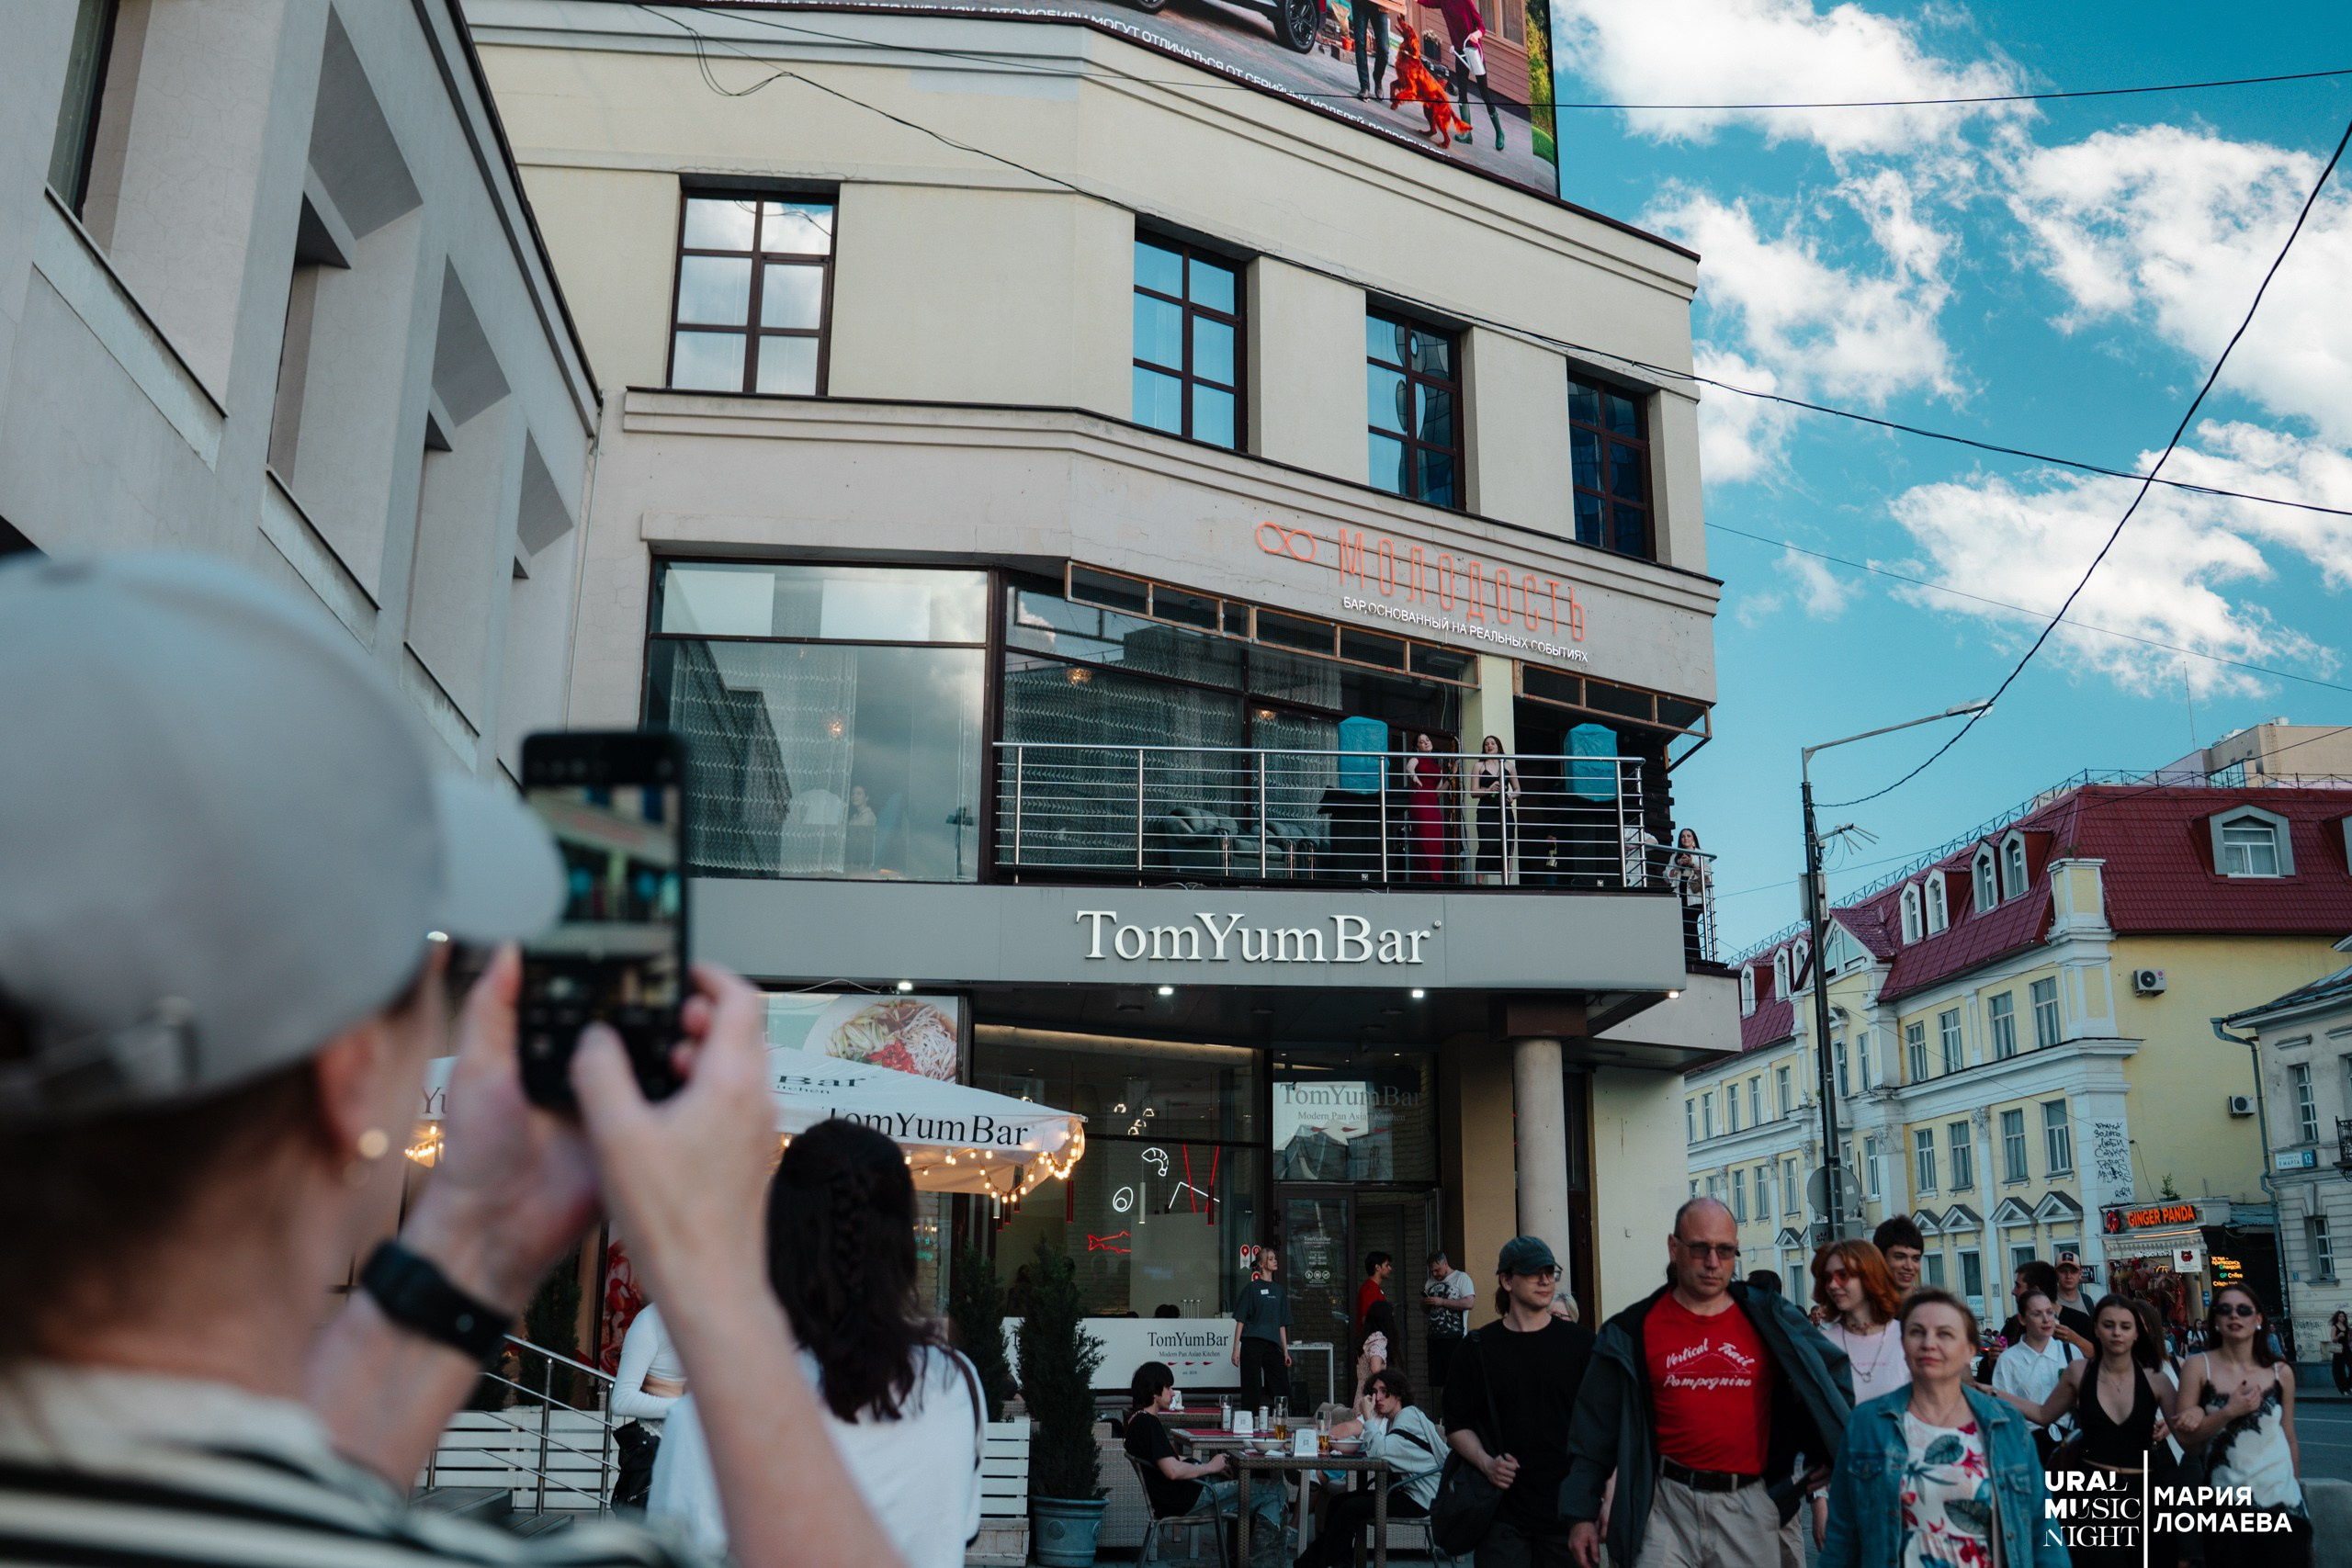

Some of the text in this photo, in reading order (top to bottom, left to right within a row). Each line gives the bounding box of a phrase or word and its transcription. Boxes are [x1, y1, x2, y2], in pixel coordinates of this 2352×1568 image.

[1091, 15, 1139, 38] МОГУТ
[1142, 30, 1224, 69] ОТЛИЧАТЬСЯ
[1227, 65, 1243, 78] ОТ
[1339, 528, 1585, 641] МОЛОДОСТЬ
[1452, 623, 1467, 636] НА
[1470, 625, 1529, 649] РЕАЛЬНЫХ
[1531, 639, 1589, 663] СОБЫТИЯХ
[1076, 910, 1431, 964] TomYumBar
[1280, 1084, 1422, 1106] TomYumBar
[822, 1107, 1028, 1146] mYumBar
[1297, 1111, 1329, 1121] Modern
[1332, 1111, 1347, 1121] Pan
[2304, 1153, 2313, 1164] 12
[2127, 1204, 2195, 1227] GINGER PANDA
[1148, 1332, 1229, 1347] TomYumBar
[1666, 1337, 1755, 1369] Vertical Trail
